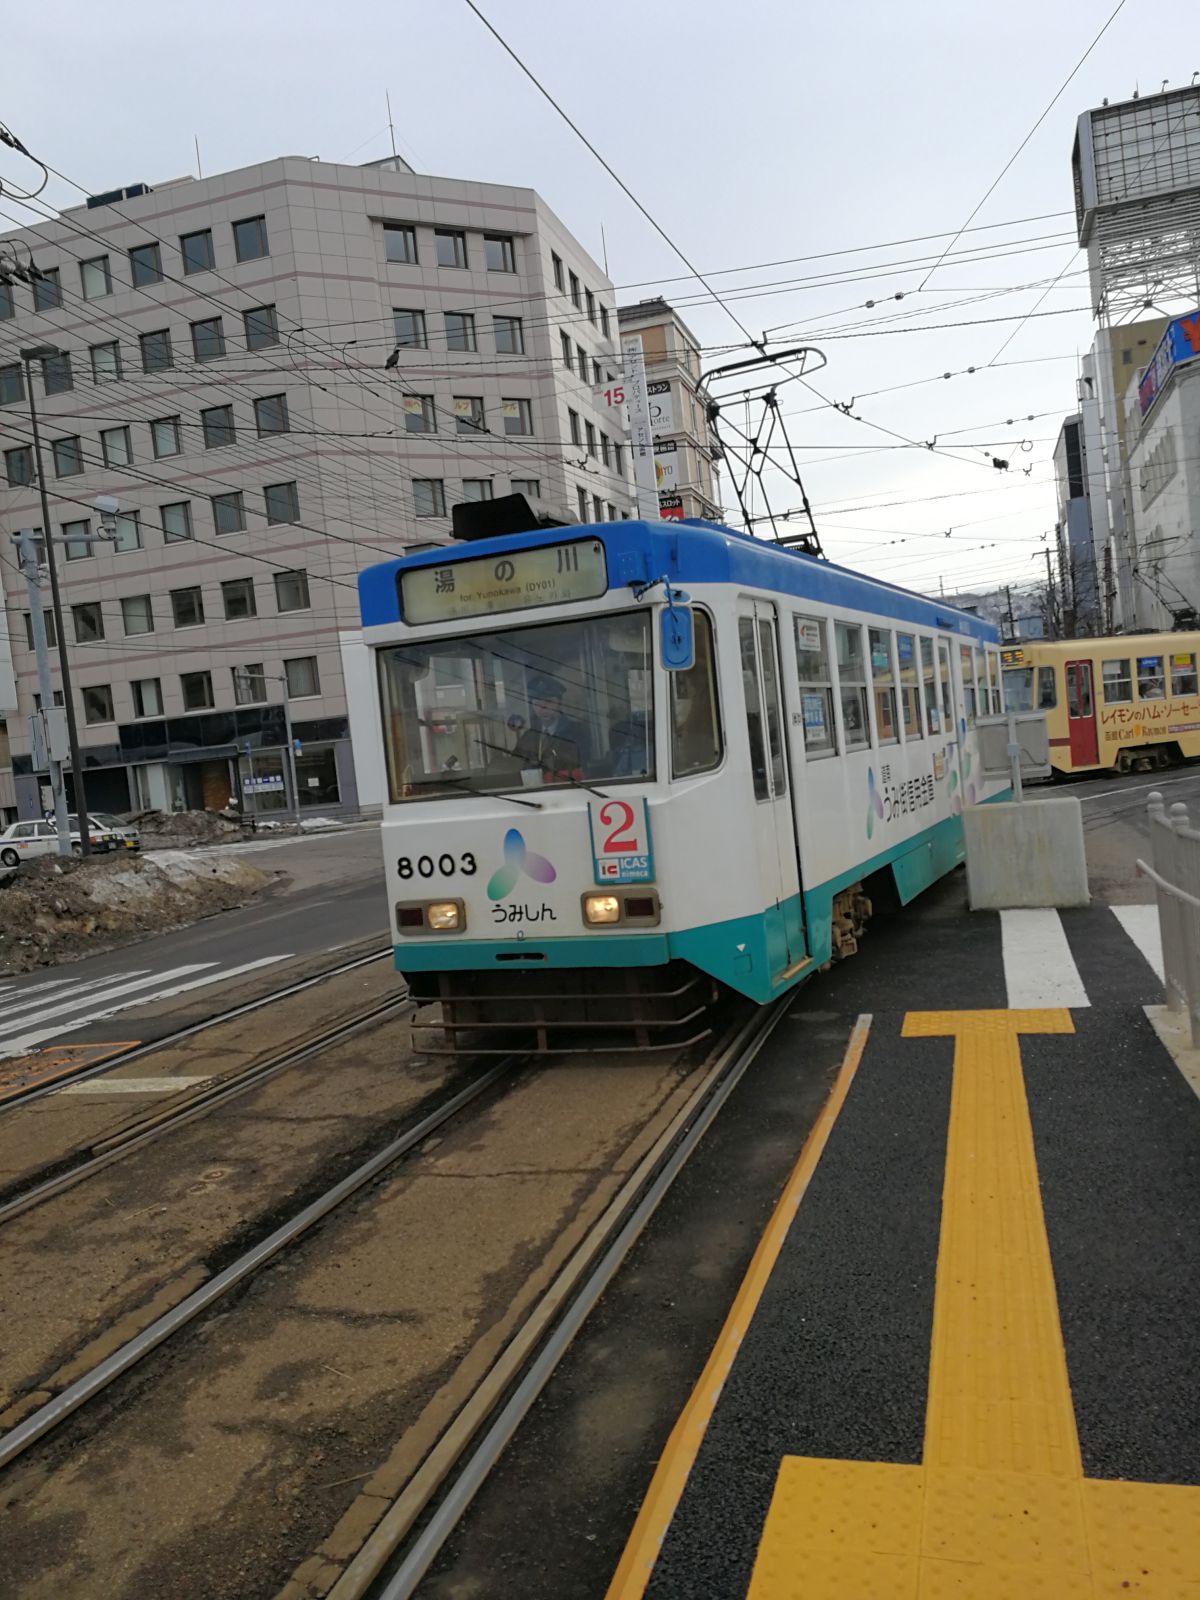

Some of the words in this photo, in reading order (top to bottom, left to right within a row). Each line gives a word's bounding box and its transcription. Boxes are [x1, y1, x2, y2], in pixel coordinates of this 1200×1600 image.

[604, 387, 625, 406] 15
[434, 546, 579, 594] 湯の川
[476, 586, 521, 599] Yunokawa
[526, 579, 555, 593] (DY01)
[1101, 701, 1200, 725] レイモンのハム・ソーセー
[600, 801, 638, 853] 2
[397, 852, 477, 879] 8003
[620, 857, 647, 868] ICAS
[491, 903, 557, 922] うみしん
